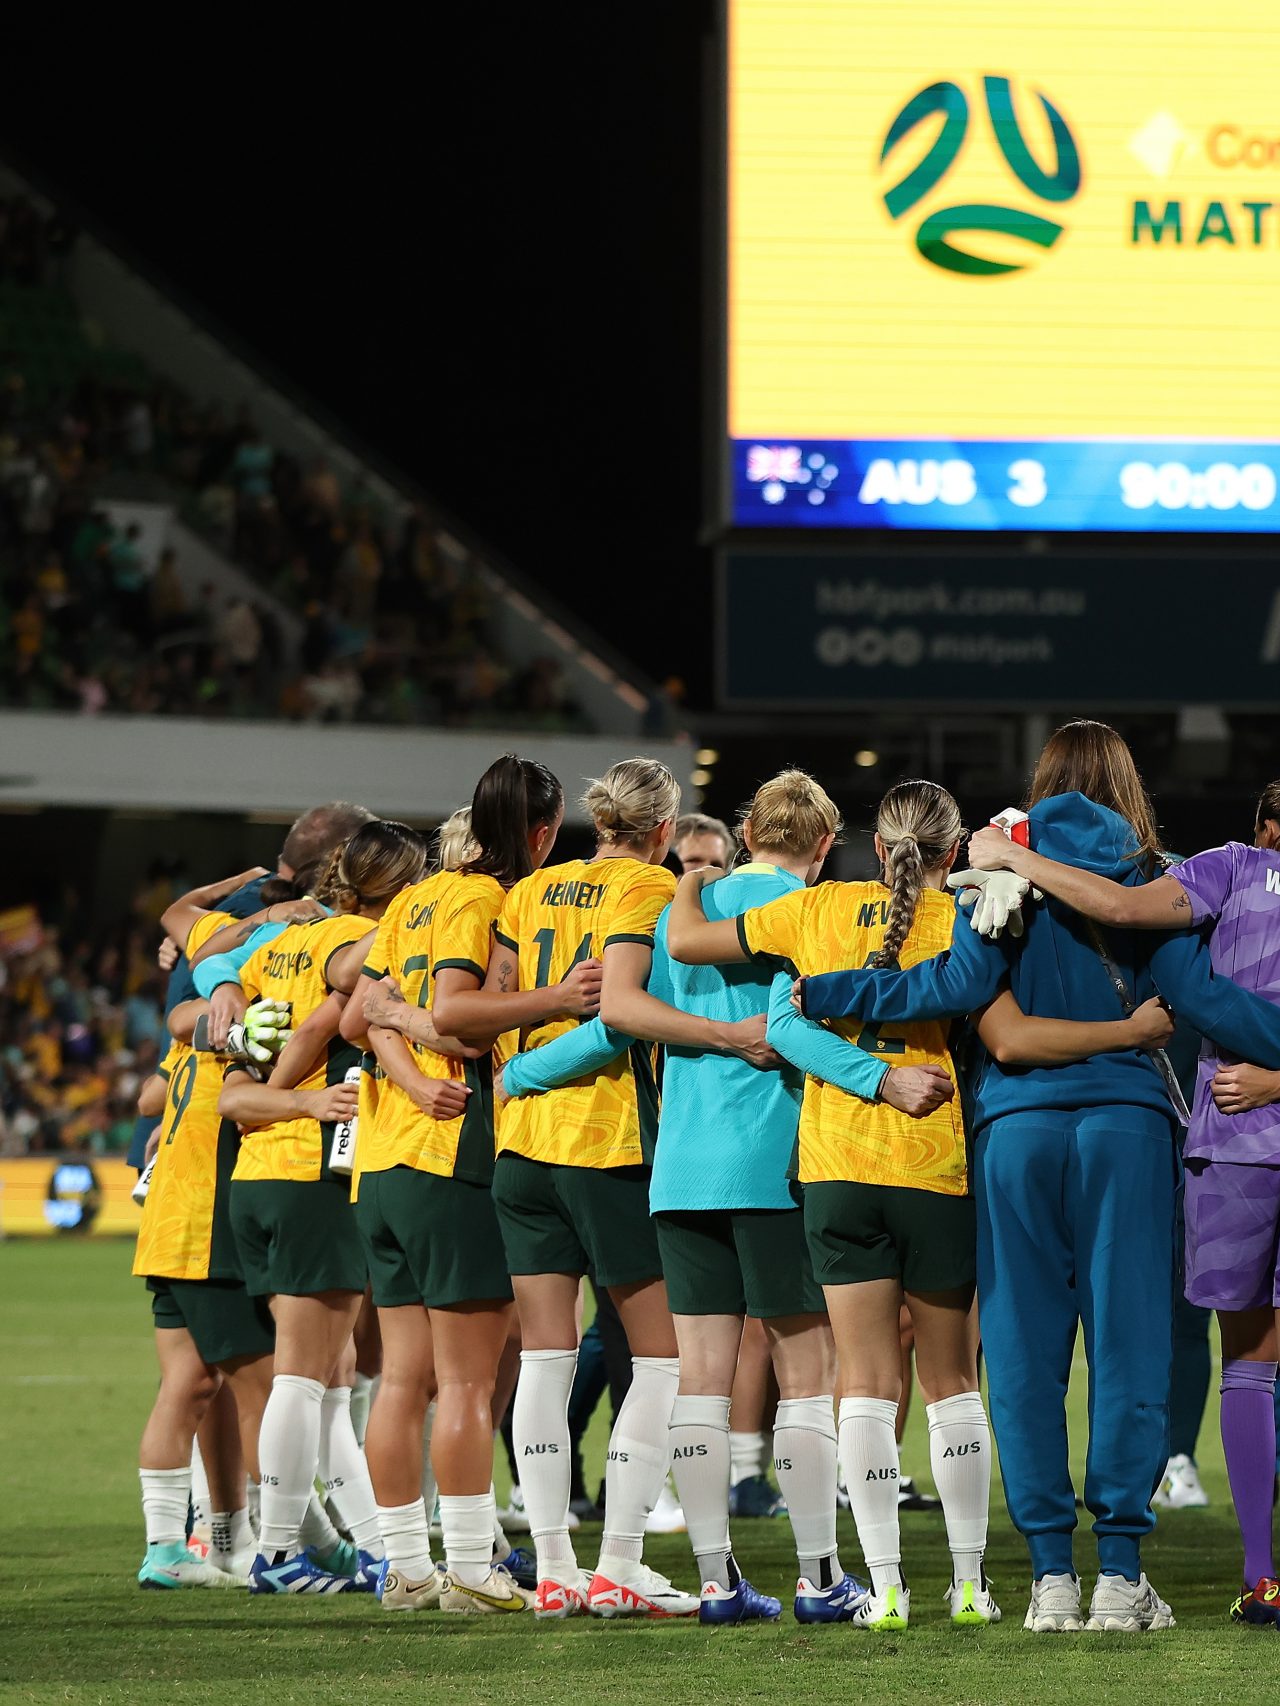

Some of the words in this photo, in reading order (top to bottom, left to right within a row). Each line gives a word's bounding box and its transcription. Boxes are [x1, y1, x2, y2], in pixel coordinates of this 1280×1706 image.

[859, 458, 977, 506] AUS
[1007, 459, 1048, 507] 3
[1120, 461, 1276, 510] 90:00
[524, 1443, 559, 1456] AUS
[672, 1444, 708, 1460] AUS
[942, 1441, 981, 1458] AUS
[774, 1457, 793, 1470] US
[262, 1473, 280, 1486] US
[865, 1467, 898, 1481] AUS
[324, 1476, 345, 1490] US
